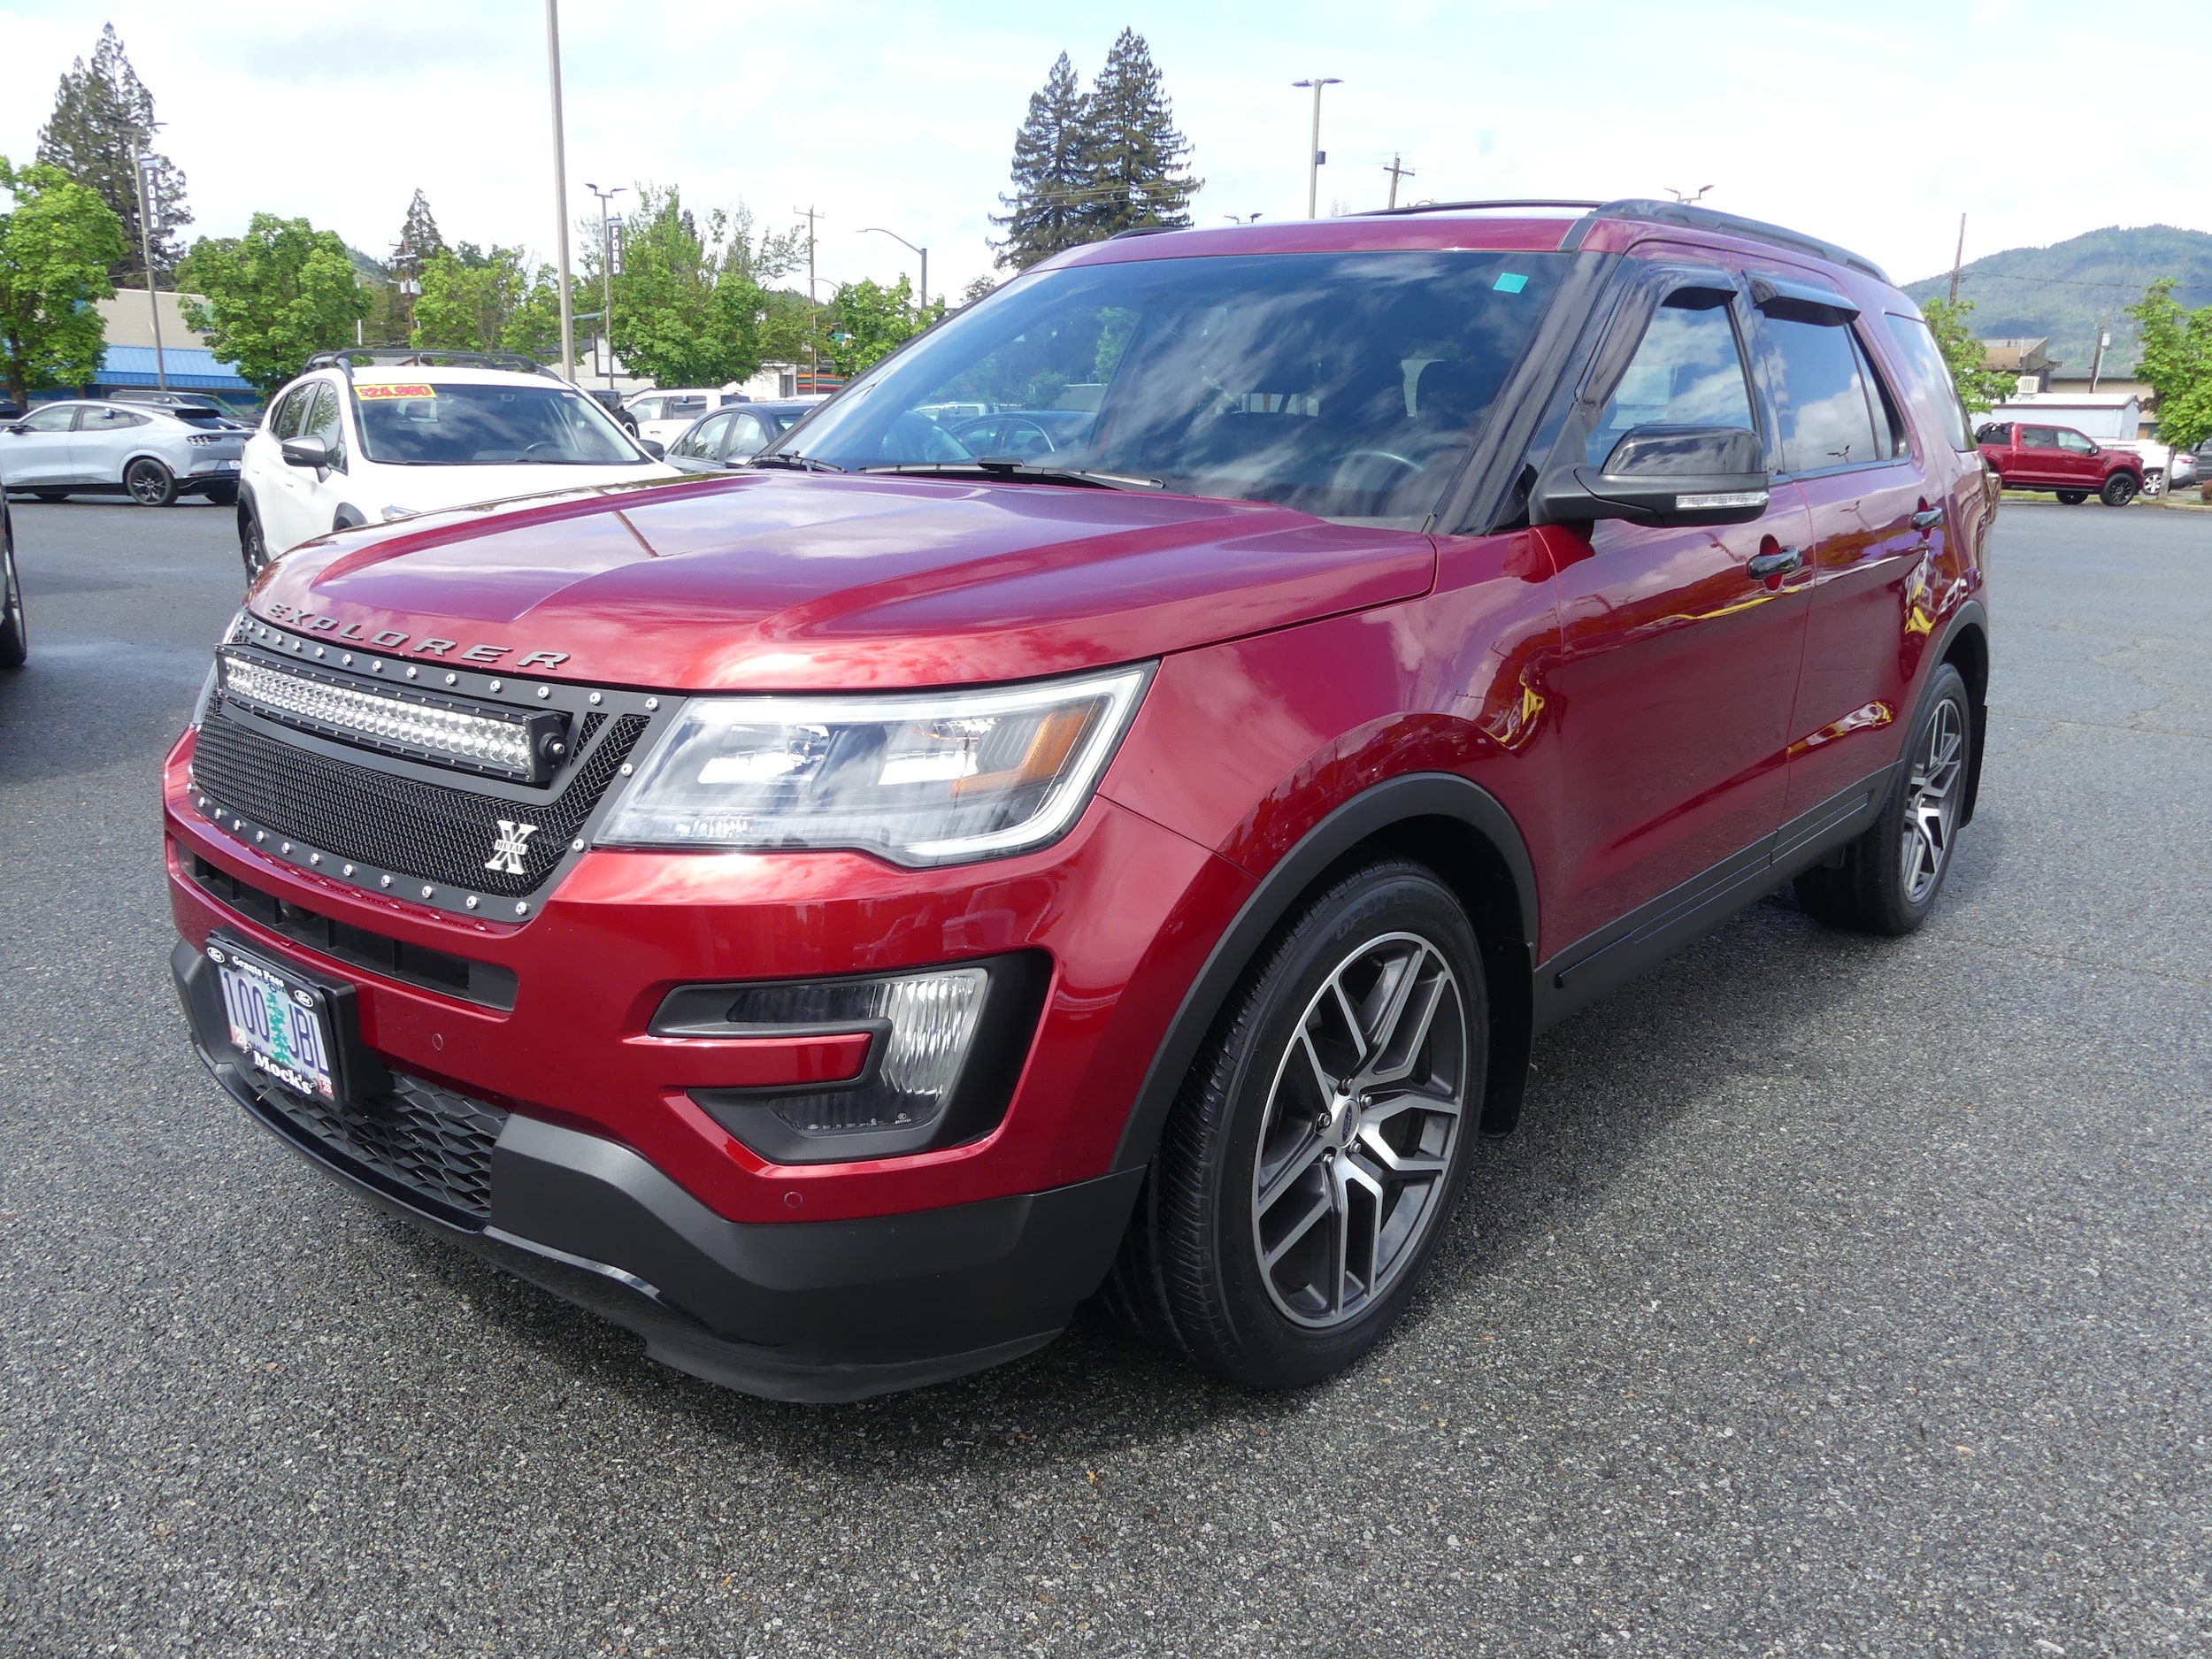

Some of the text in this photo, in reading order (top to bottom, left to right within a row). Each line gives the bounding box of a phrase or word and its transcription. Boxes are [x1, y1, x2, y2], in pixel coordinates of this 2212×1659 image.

[146, 169, 159, 228] FORD
[611, 227, 620, 274] FORD
[267, 601, 571, 670] EXPLORER
[495, 840, 525, 854] METAL
[1333, 894, 1388, 941] OPEN
[232, 955, 263, 977] Grants
[262, 970, 284, 987] Pass
[224, 971, 329, 1077] 100 JBL
[253, 1050, 312, 1095] Mock's
